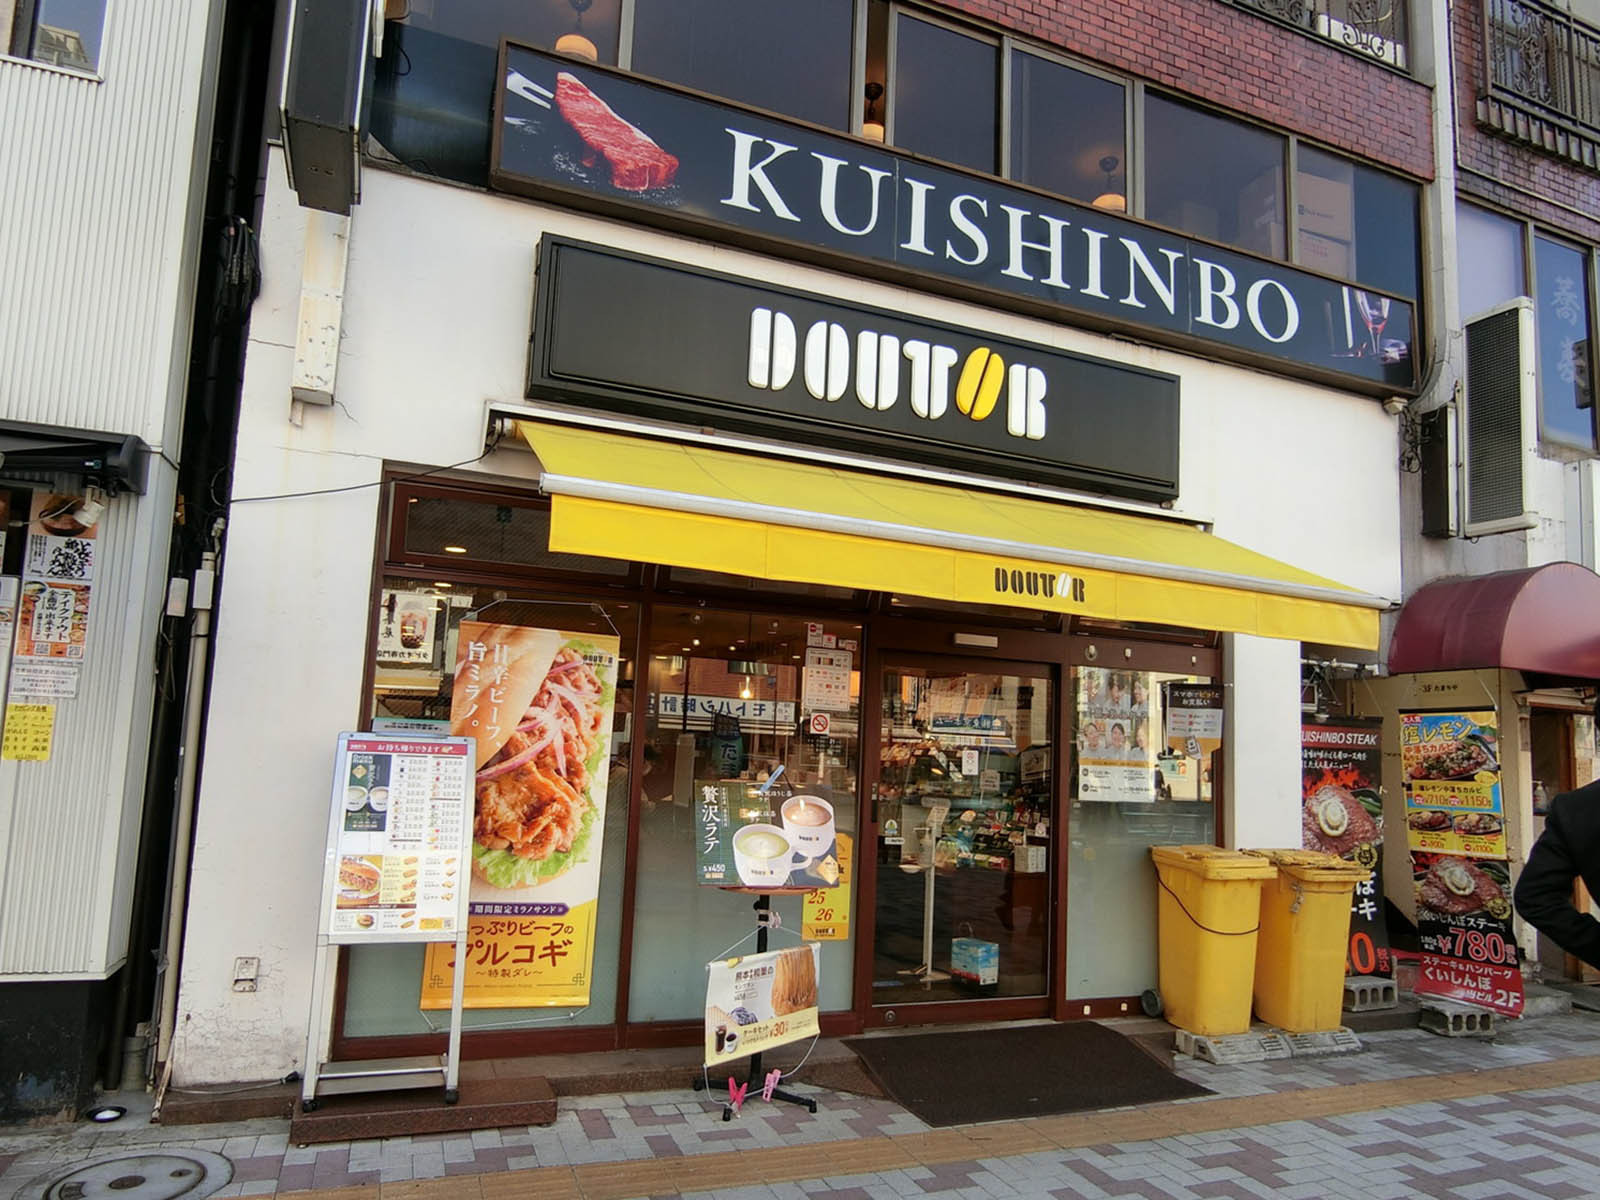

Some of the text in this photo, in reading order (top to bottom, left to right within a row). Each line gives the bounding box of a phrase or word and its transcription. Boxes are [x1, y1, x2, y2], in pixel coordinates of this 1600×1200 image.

[720, 127, 1300, 344] KUISHINBO
[748, 306, 1047, 440] DOUTOR
[994, 567, 1085, 602] DOUTOR
[1346, 732, 1377, 745] STEAK
[1403, 721, 1472, 745] 塩レモン
[702, 785, 720, 854] 贅沢ラテ
[474, 904, 557, 915] 期間限定ミラノサンド
[808, 891, 825, 905] 25
[815, 908, 833, 921] 26
[468, 920, 574, 937] っぷりビーフの
[1437, 927, 1505, 964] ¥780
[1376, 946, 1390, 972] 税込
[1425, 967, 1492, 991] くいしんぼ
[1494, 989, 1521, 1008] 2F
